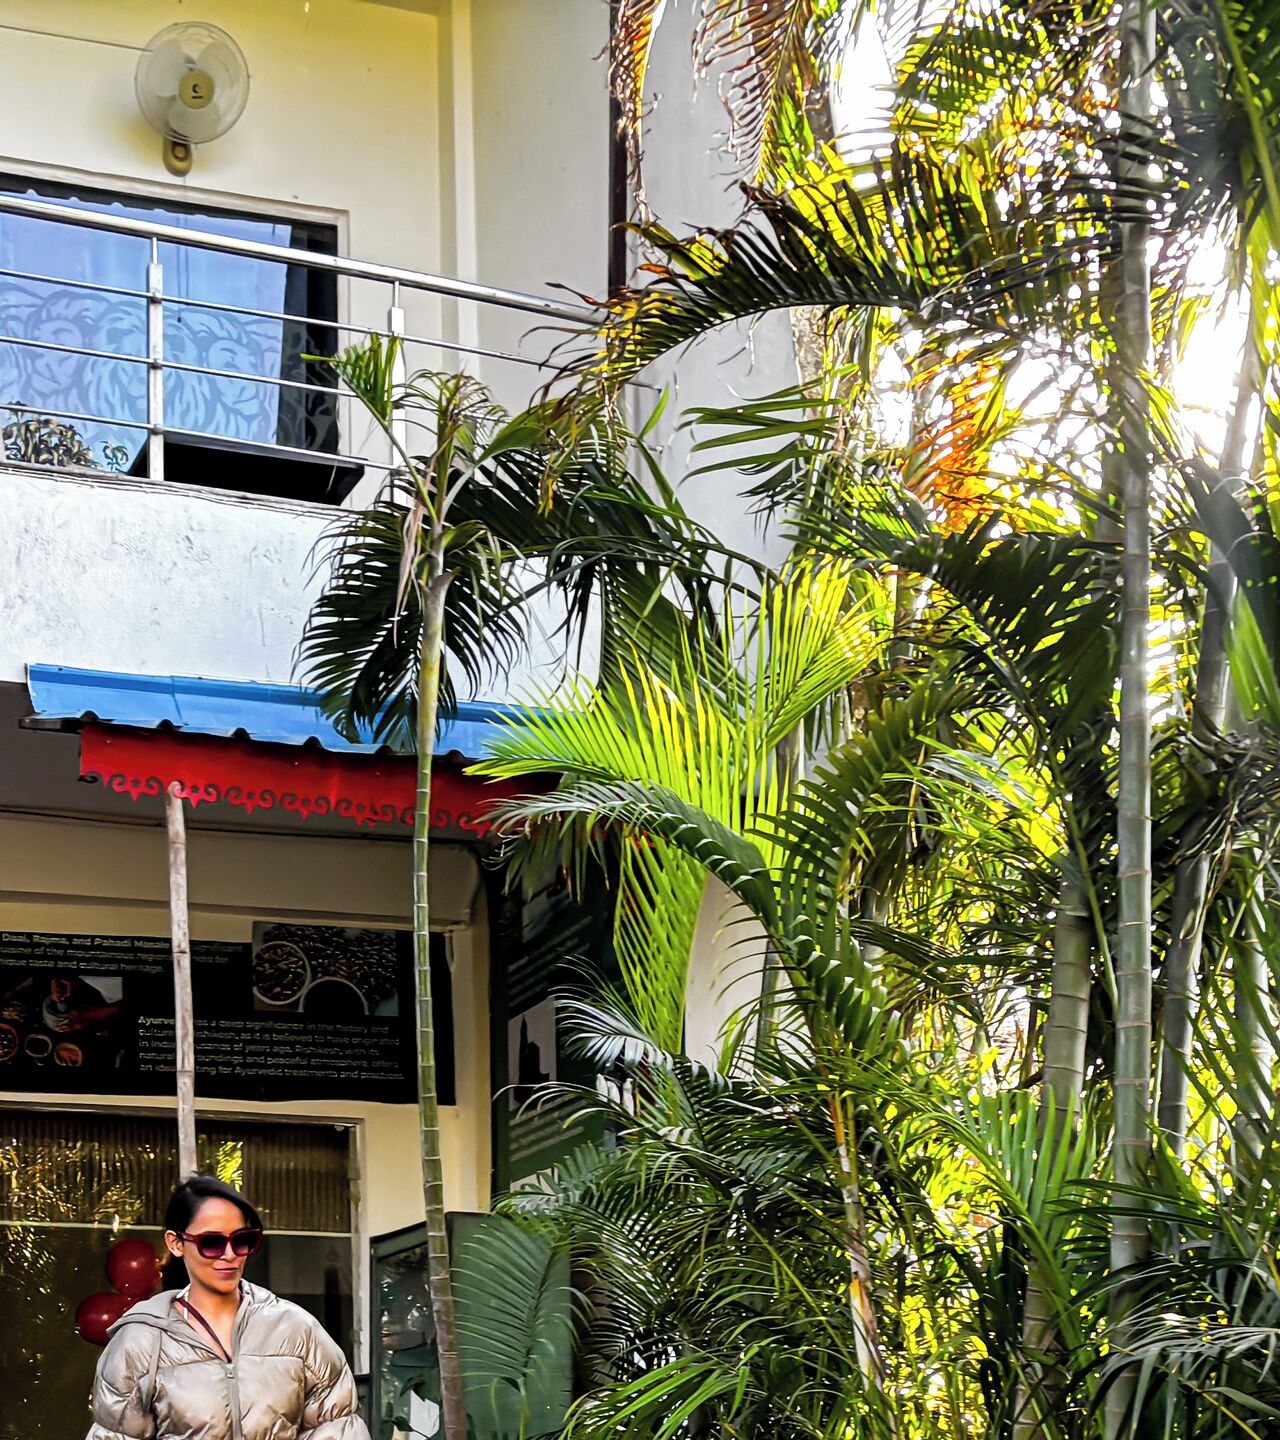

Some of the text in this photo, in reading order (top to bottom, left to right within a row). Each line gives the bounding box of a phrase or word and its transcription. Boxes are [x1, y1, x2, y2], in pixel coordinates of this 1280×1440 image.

[71, 937, 91, 946] and
[94, 938, 131, 948] Pahadi
[33, 947, 45, 955] of
[46, 947, 65, 956] the
[56, 960, 77, 969] and
[78, 961, 118, 971] cultural
[317, 1023, 335, 1031] the
[370, 1025, 390, 1033] and
[272, 1033, 313, 1042] believed
[139, 1039, 149, 1047] in
[233, 1043, 243, 1051] of
[245, 1055, 265, 1063] and
[139, 1064, 153, 1072] an
[218, 1066, 232, 1074] for
[234, 1067, 284, 1077] Ayurvedic
[339, 1070, 359, 1078] and
